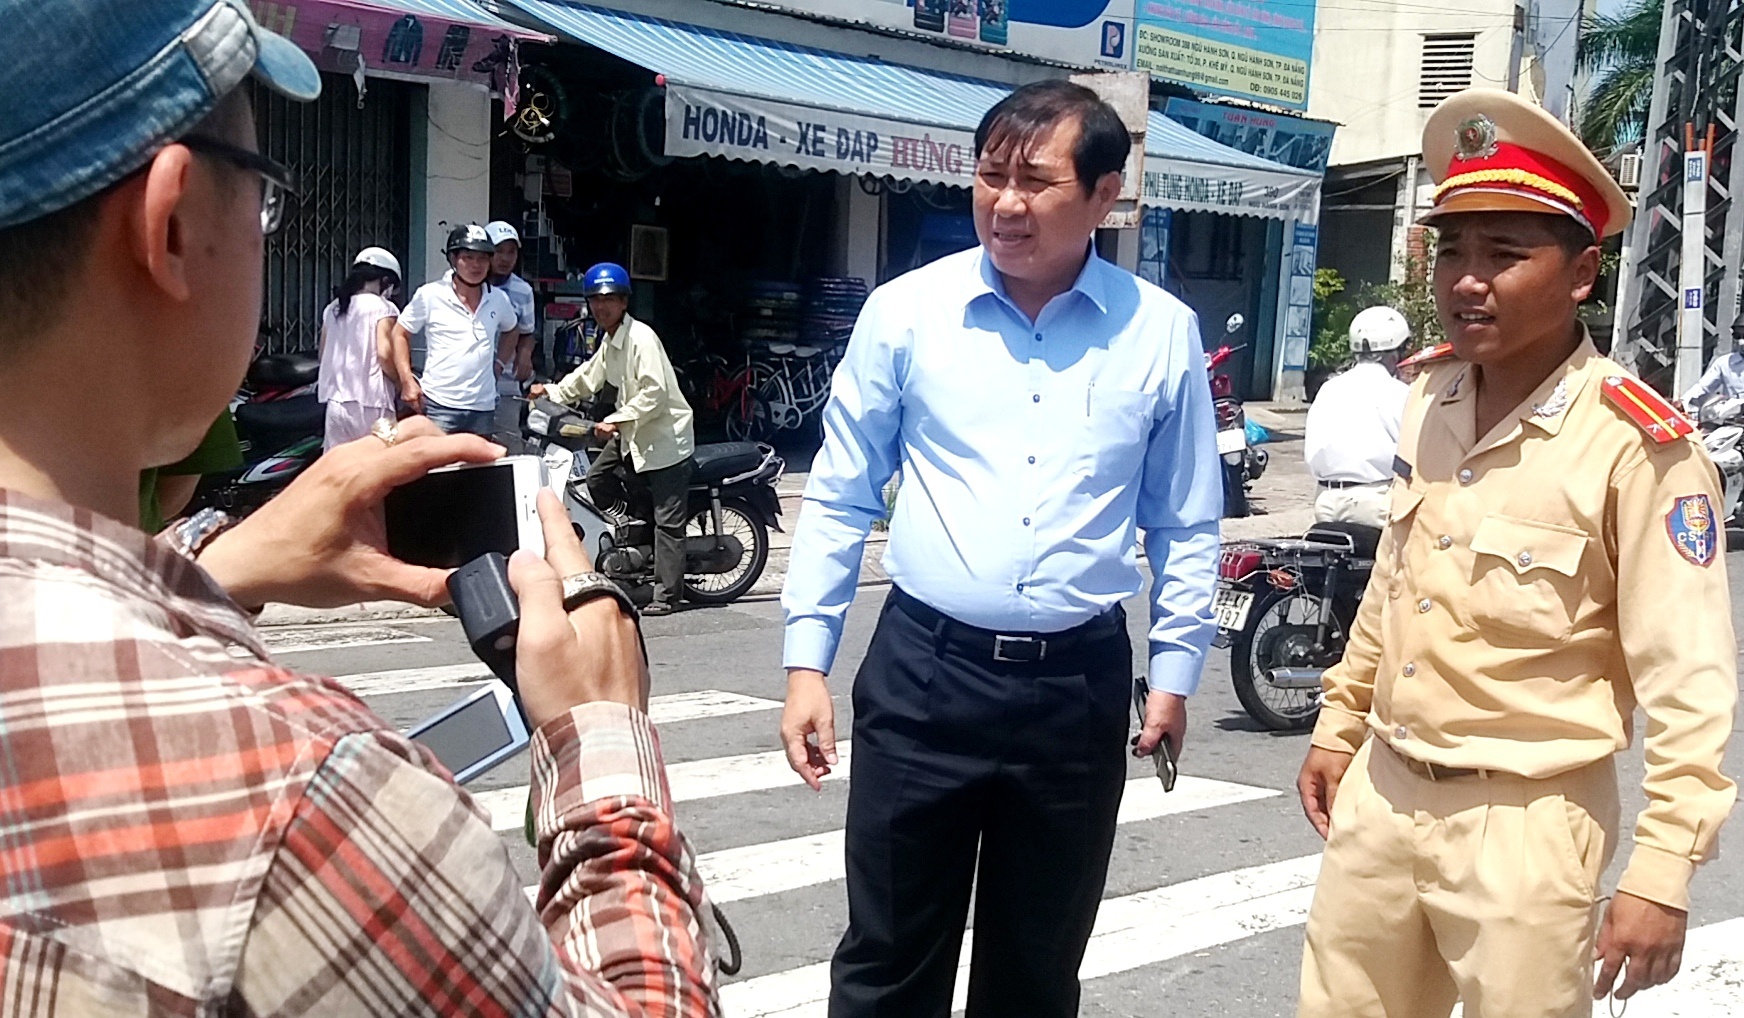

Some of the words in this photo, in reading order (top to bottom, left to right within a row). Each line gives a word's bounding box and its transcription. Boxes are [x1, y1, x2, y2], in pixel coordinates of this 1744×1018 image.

[1150, 32, 1180, 47] SHOWROOM
[1250, 82, 1262, 92] DĐ:
[1263, 85, 1278, 96] 0905
[1280, 88, 1290, 98] 445
[1291, 91, 1303, 101] 026
[683, 105, 769, 150] HONDA
[796, 121, 826, 157] XE
[1184, 174, 1209, 204] HONDA
